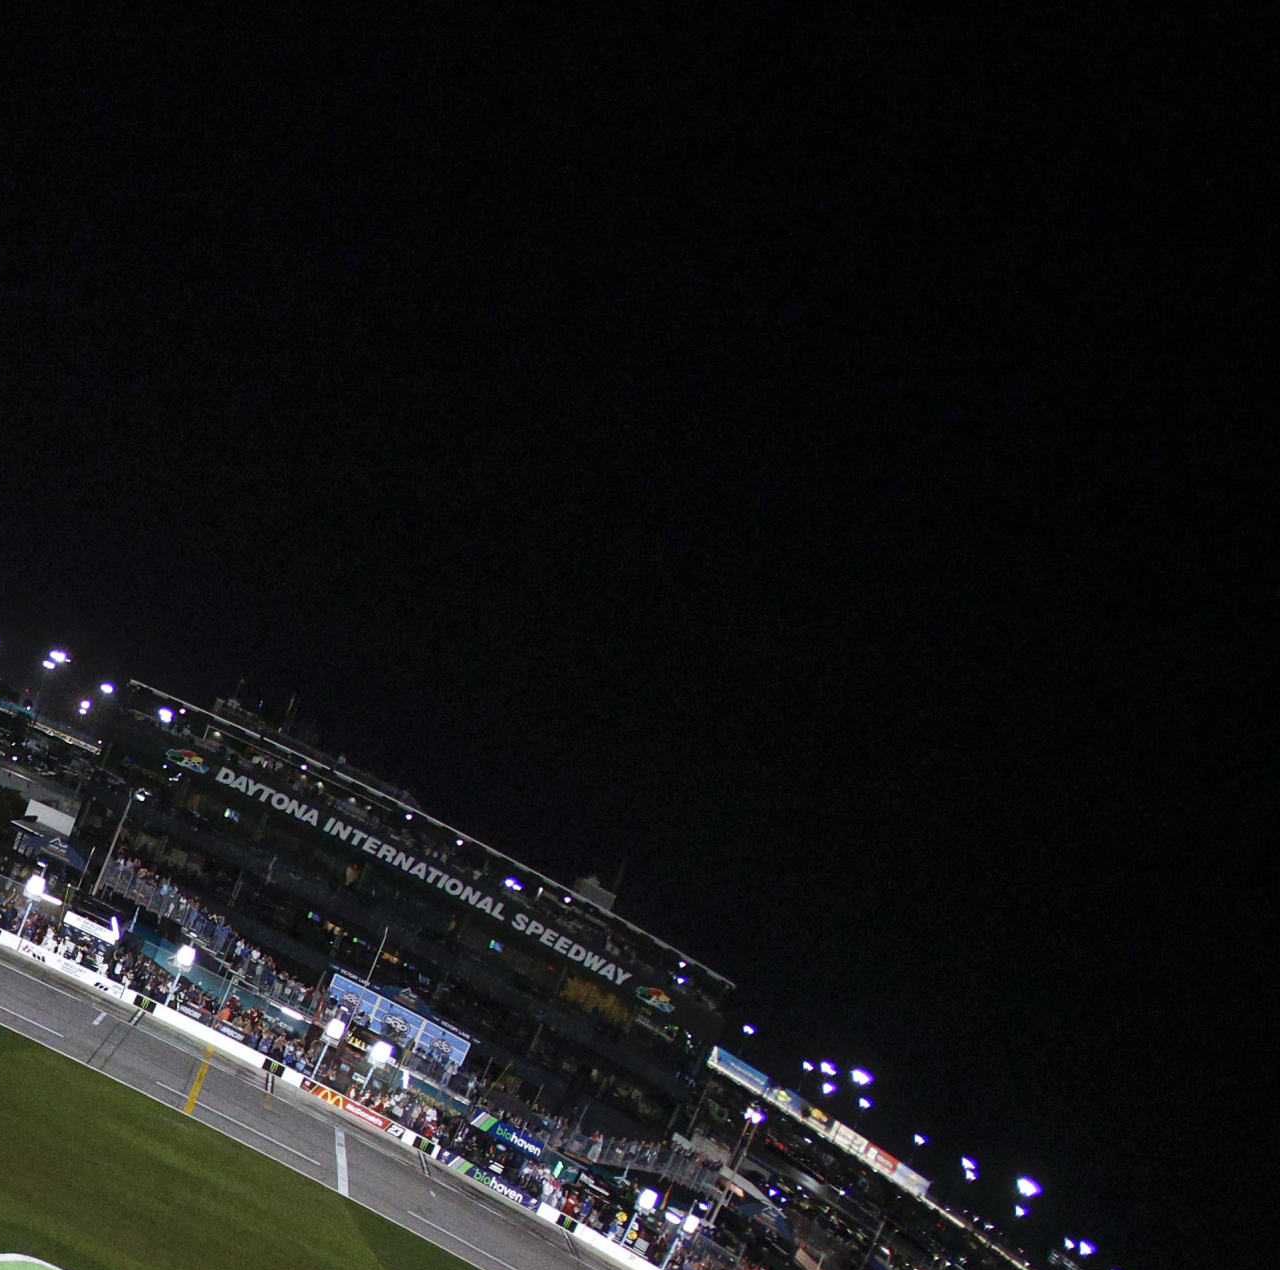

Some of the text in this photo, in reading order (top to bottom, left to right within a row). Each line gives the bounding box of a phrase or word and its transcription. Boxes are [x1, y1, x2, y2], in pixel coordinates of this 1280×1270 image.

[215, 766, 633, 987] DAYTONA INTERNATIONAL SPEEDWAY
[495, 1125, 541, 1157] biohaven
[473, 1169, 524, 1204] biohaven
